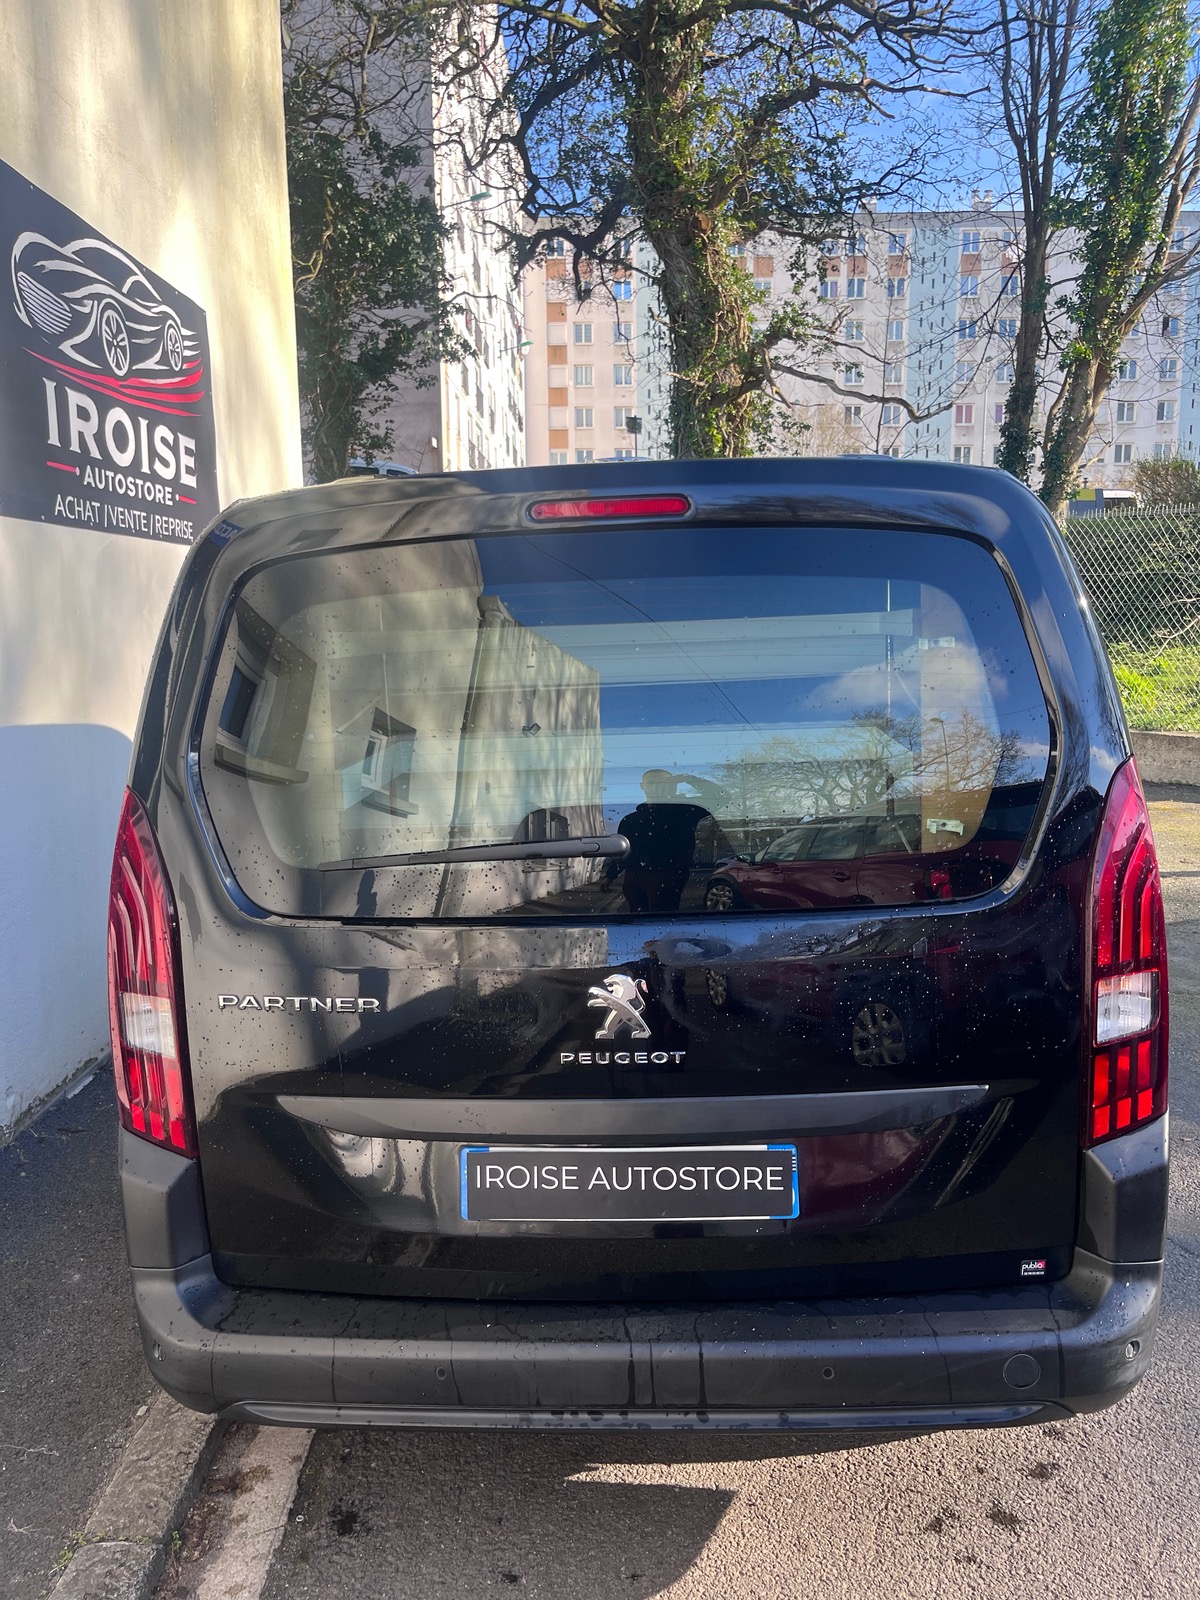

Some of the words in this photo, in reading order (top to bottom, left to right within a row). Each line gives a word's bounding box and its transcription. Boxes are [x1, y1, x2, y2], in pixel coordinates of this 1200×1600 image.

[42, 376, 198, 489] IROISE
[83, 464, 174, 506] AUTOSTORE
[54, 493, 101, 524] ACHAT
[217, 994, 381, 1013] PARTNER
[559, 1050, 687, 1066] PEUGEOT
